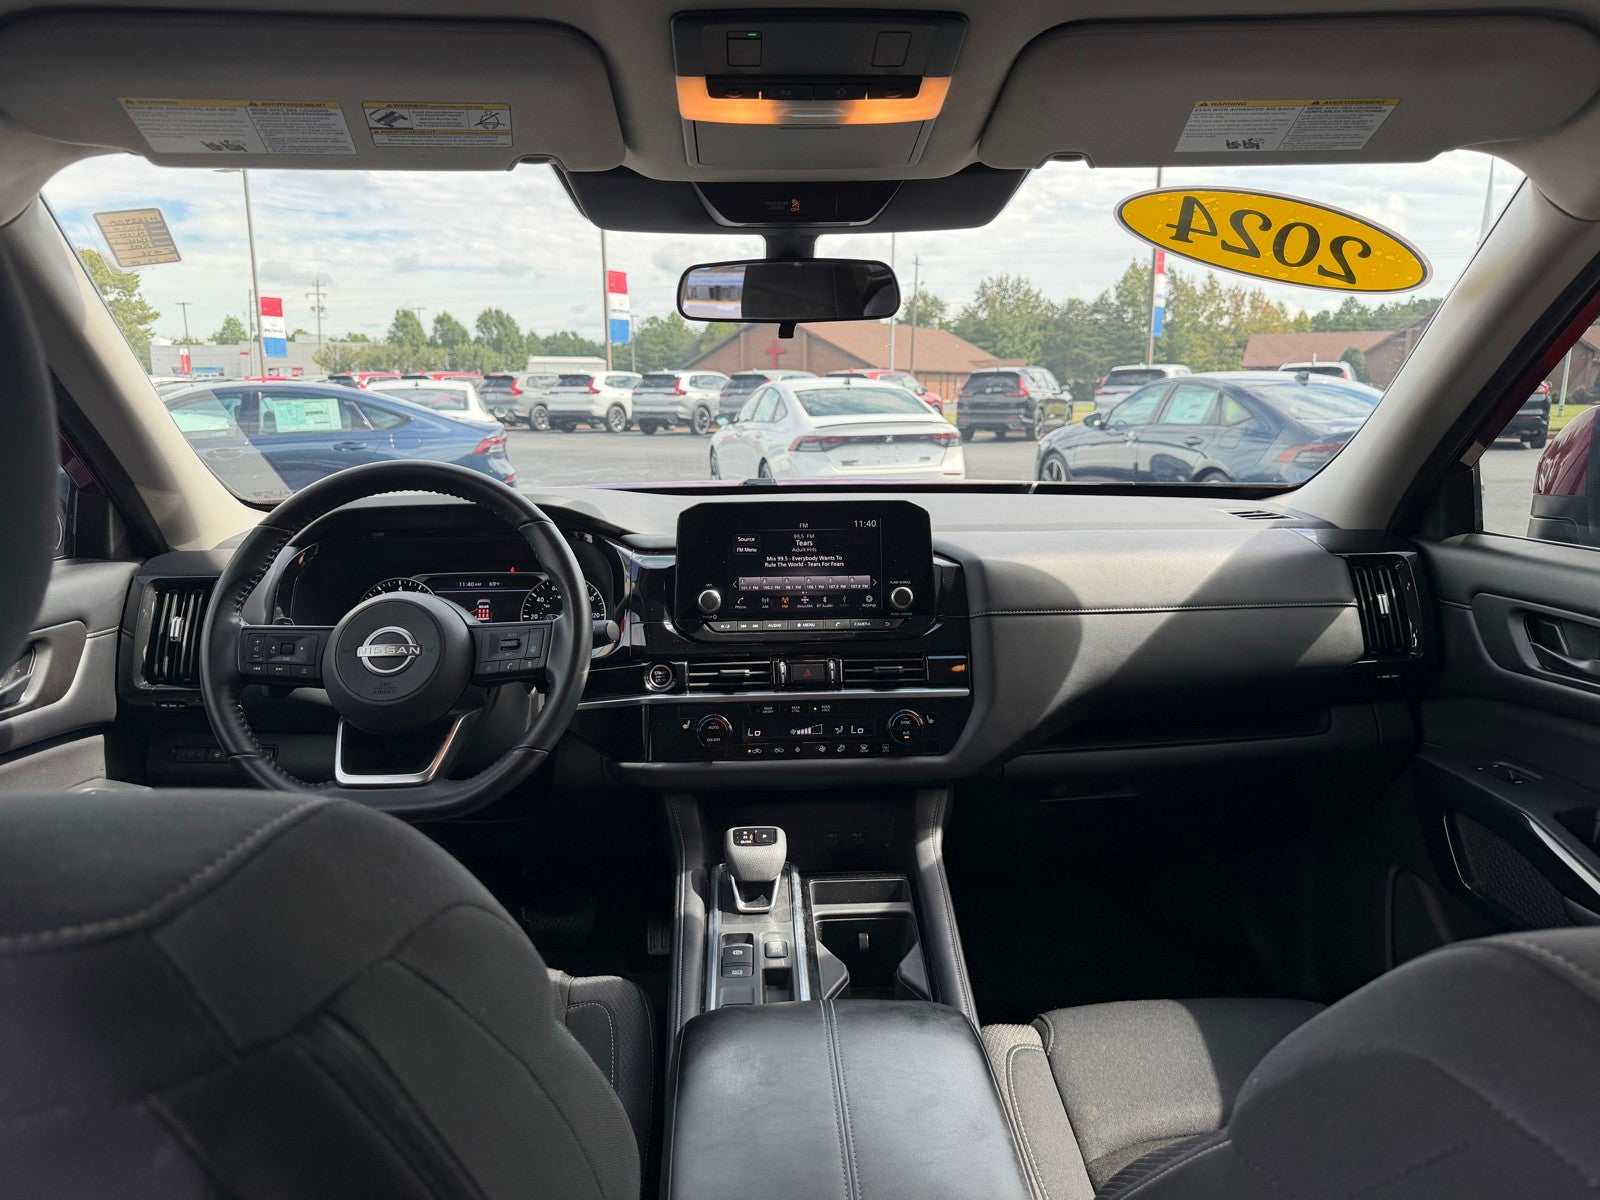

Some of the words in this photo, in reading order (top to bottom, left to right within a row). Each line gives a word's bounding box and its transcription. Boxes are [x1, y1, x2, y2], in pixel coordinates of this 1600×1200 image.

[358, 646, 420, 655] NISSAN
[748, 728, 761, 736] Lo
[851, 725, 864, 734] Lo
